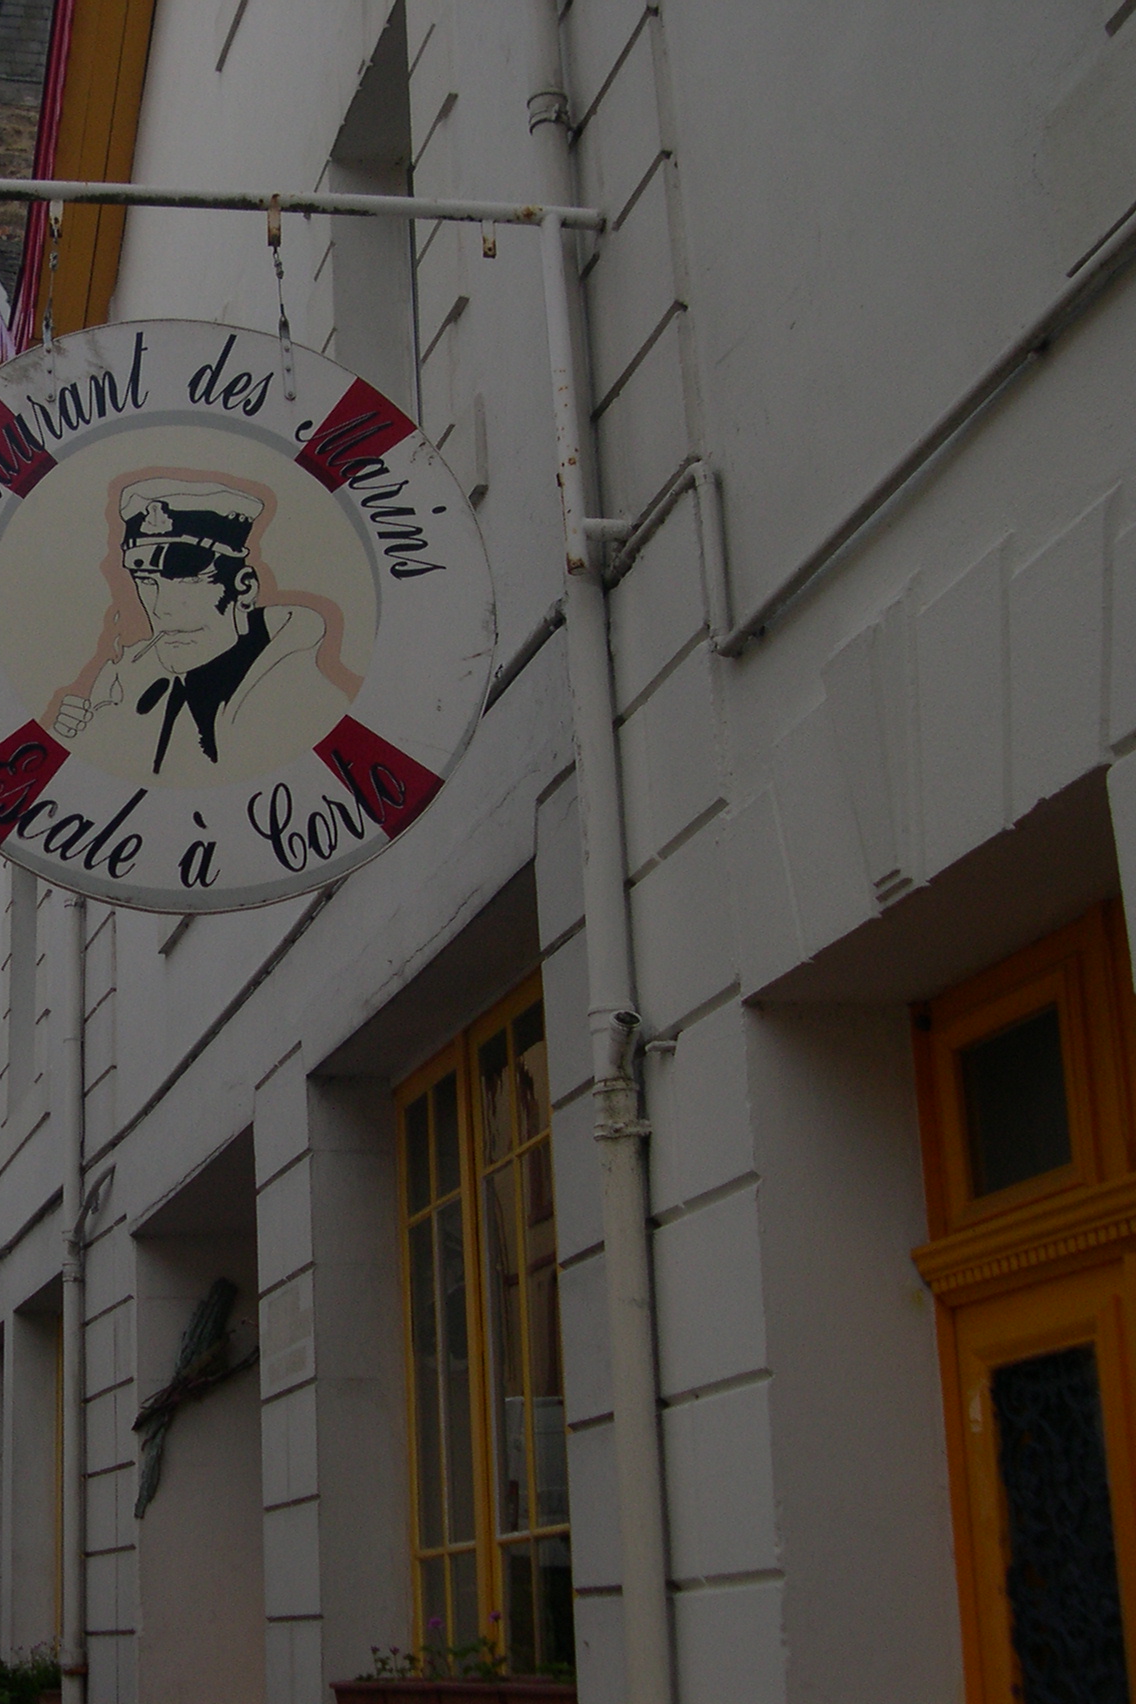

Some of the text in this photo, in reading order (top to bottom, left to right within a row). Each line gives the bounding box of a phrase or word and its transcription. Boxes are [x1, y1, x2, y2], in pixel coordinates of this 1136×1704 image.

[187, 334, 274, 416] des
[295, 411, 447, 581] Marins
[178, 812, 221, 888] à
[248, 749, 406, 873] Corto
